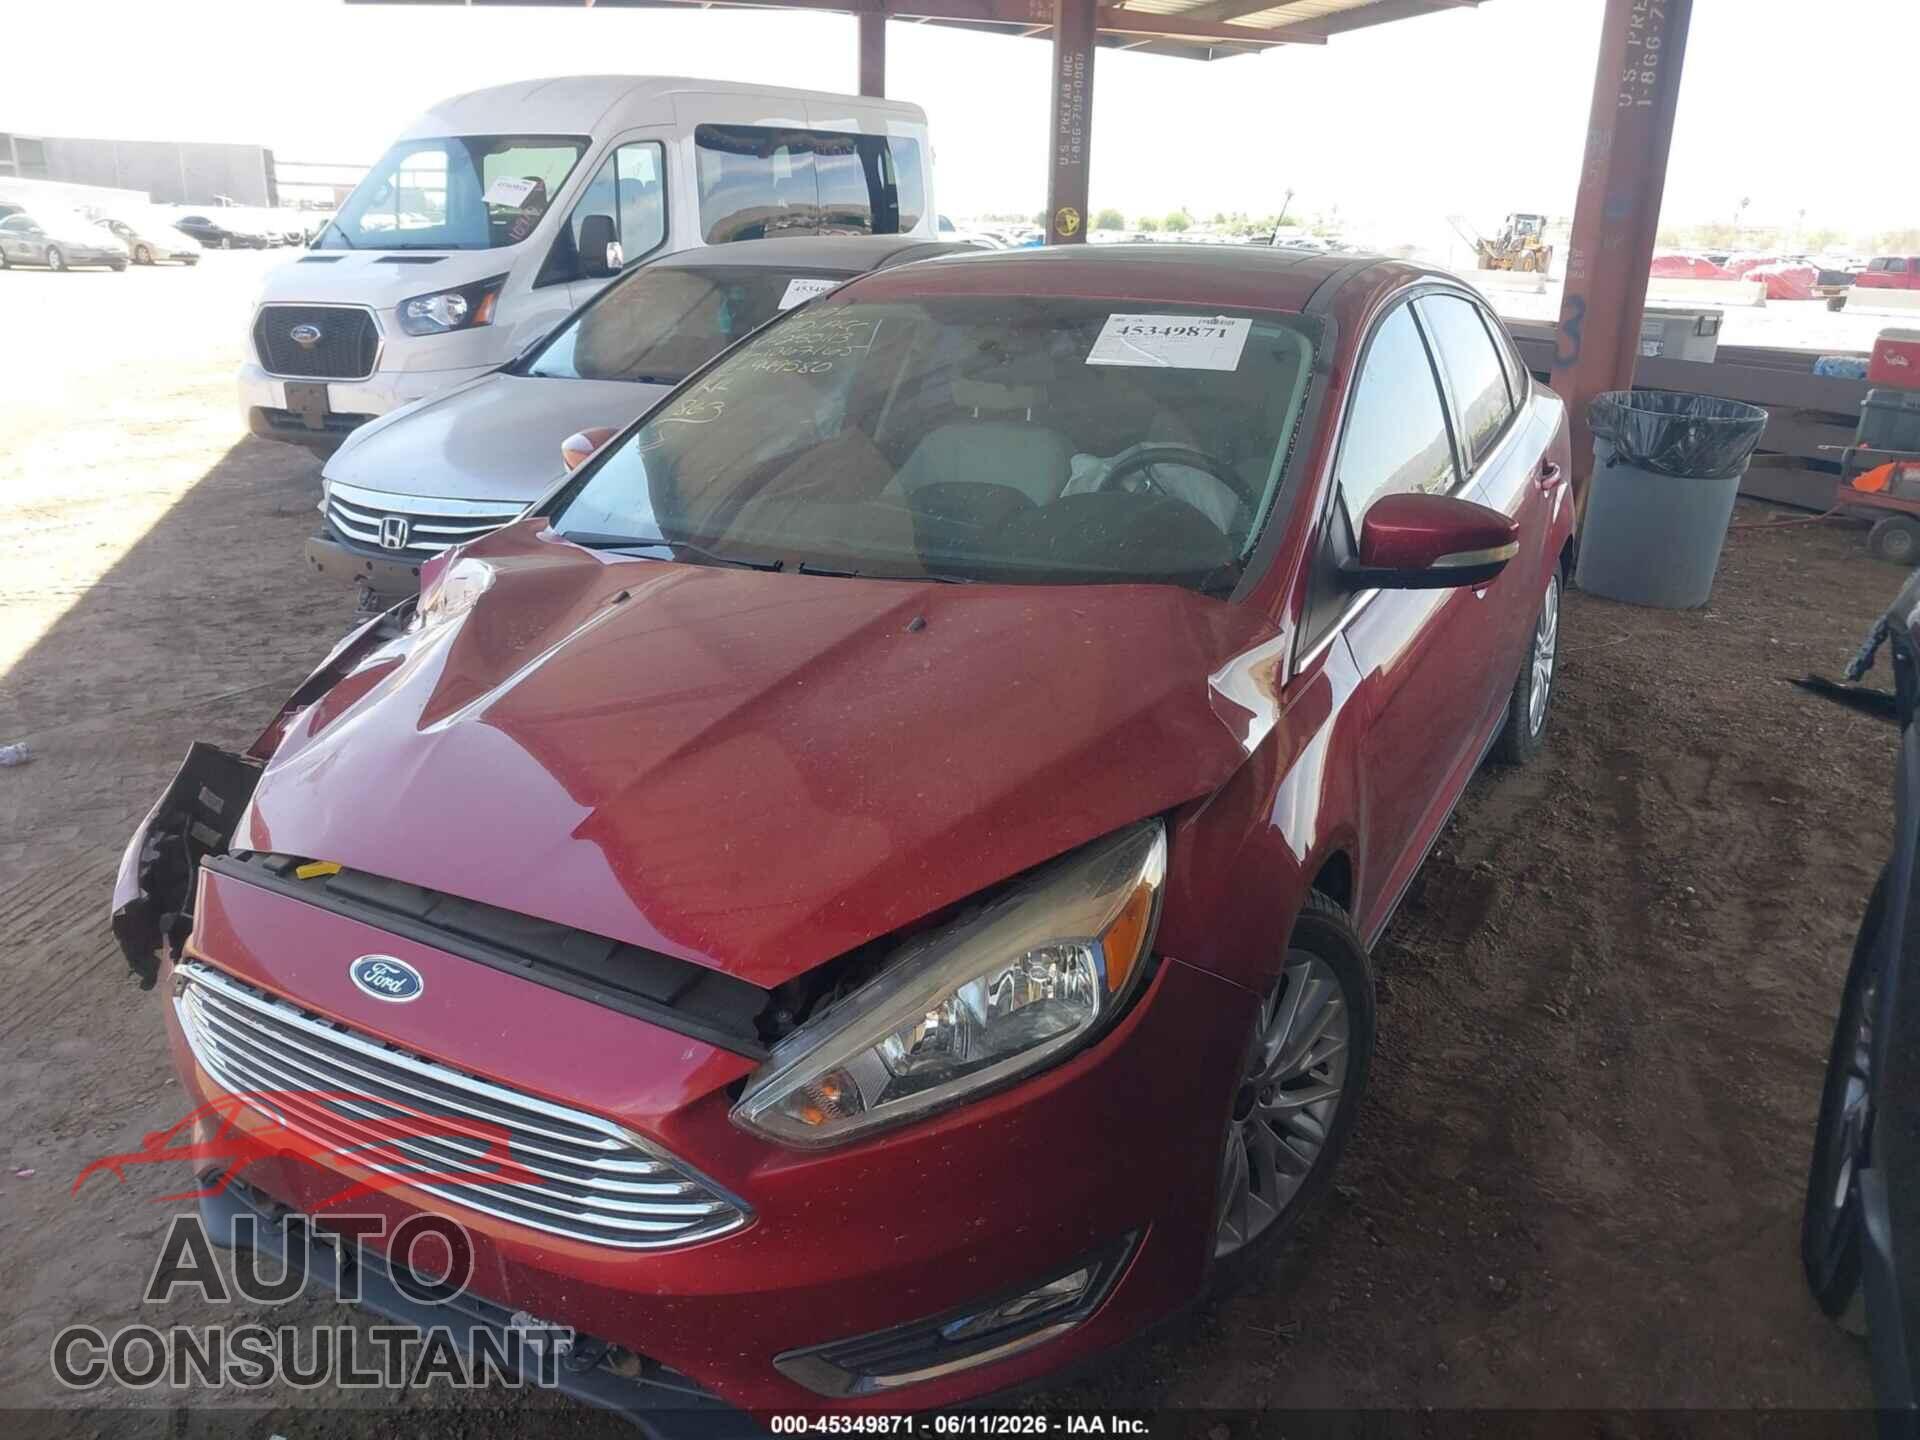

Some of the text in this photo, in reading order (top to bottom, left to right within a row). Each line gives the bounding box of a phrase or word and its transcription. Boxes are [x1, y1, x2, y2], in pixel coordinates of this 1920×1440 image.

[1637, 0, 1666, 107] 1-866-7
[1618, 61, 1639, 107] U.S.
[1116, 325, 1227, 338] 45349871
[1551, 292, 1585, 369] 3
[363, 962, 408, 993] Ford
